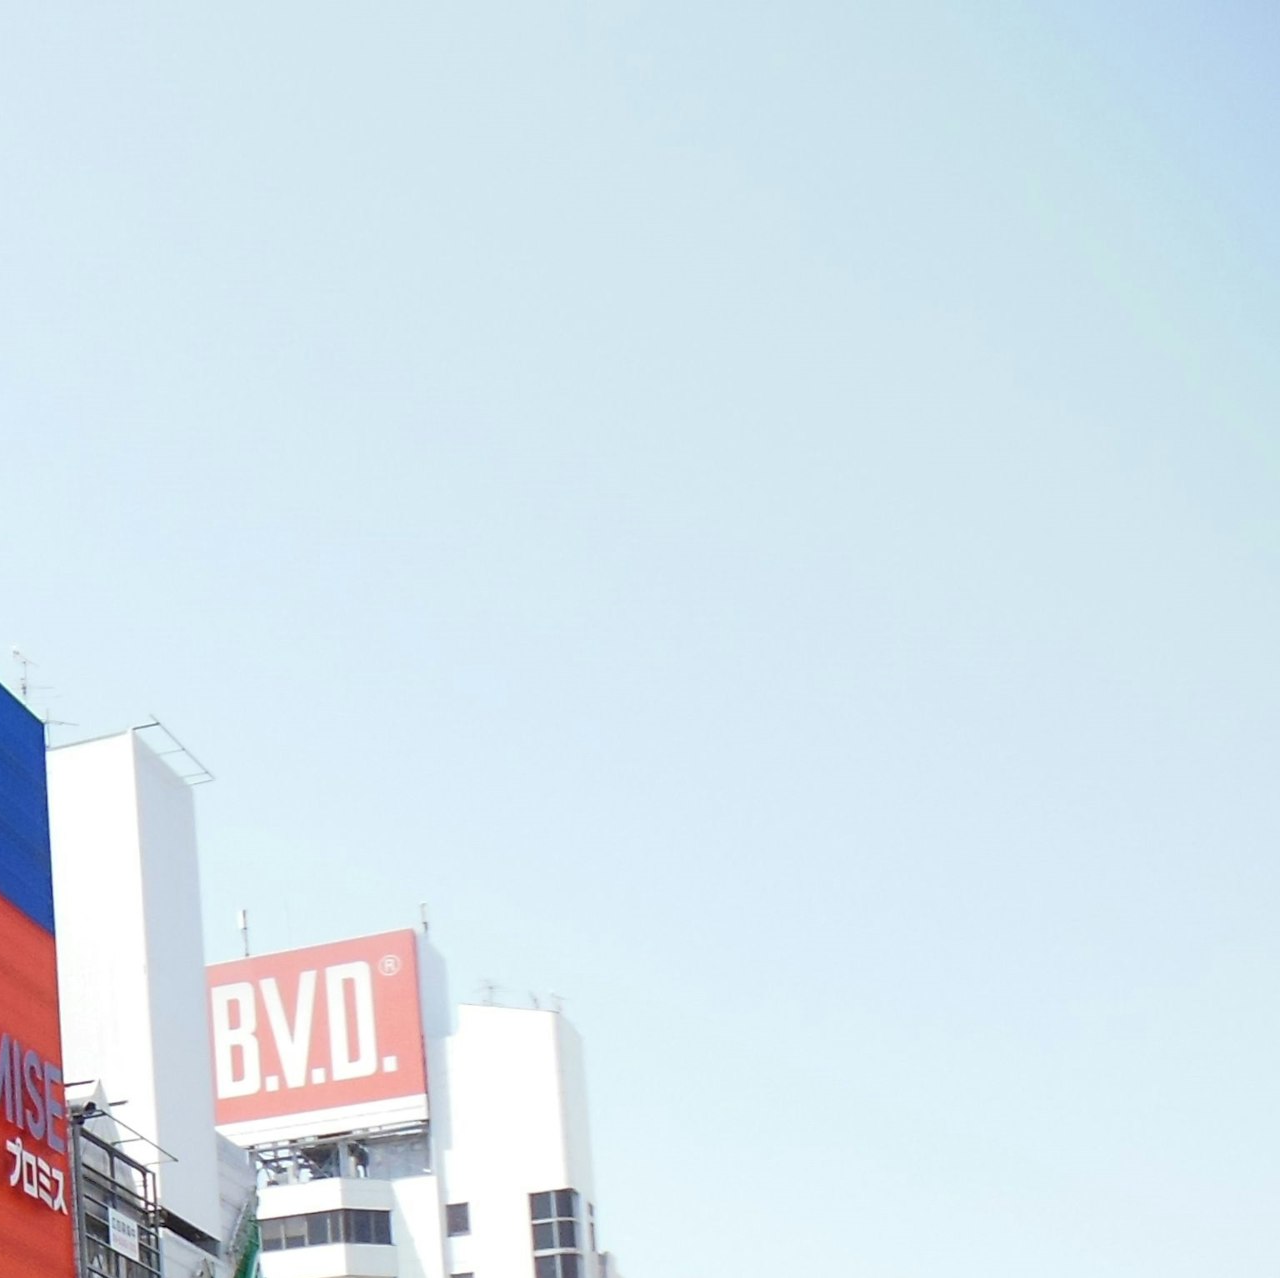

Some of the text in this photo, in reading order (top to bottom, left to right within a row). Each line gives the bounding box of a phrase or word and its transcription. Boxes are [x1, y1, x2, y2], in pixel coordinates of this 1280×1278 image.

[209, 958, 398, 1101] B.V.D.
[5, 1136, 69, 1216] プロミス
